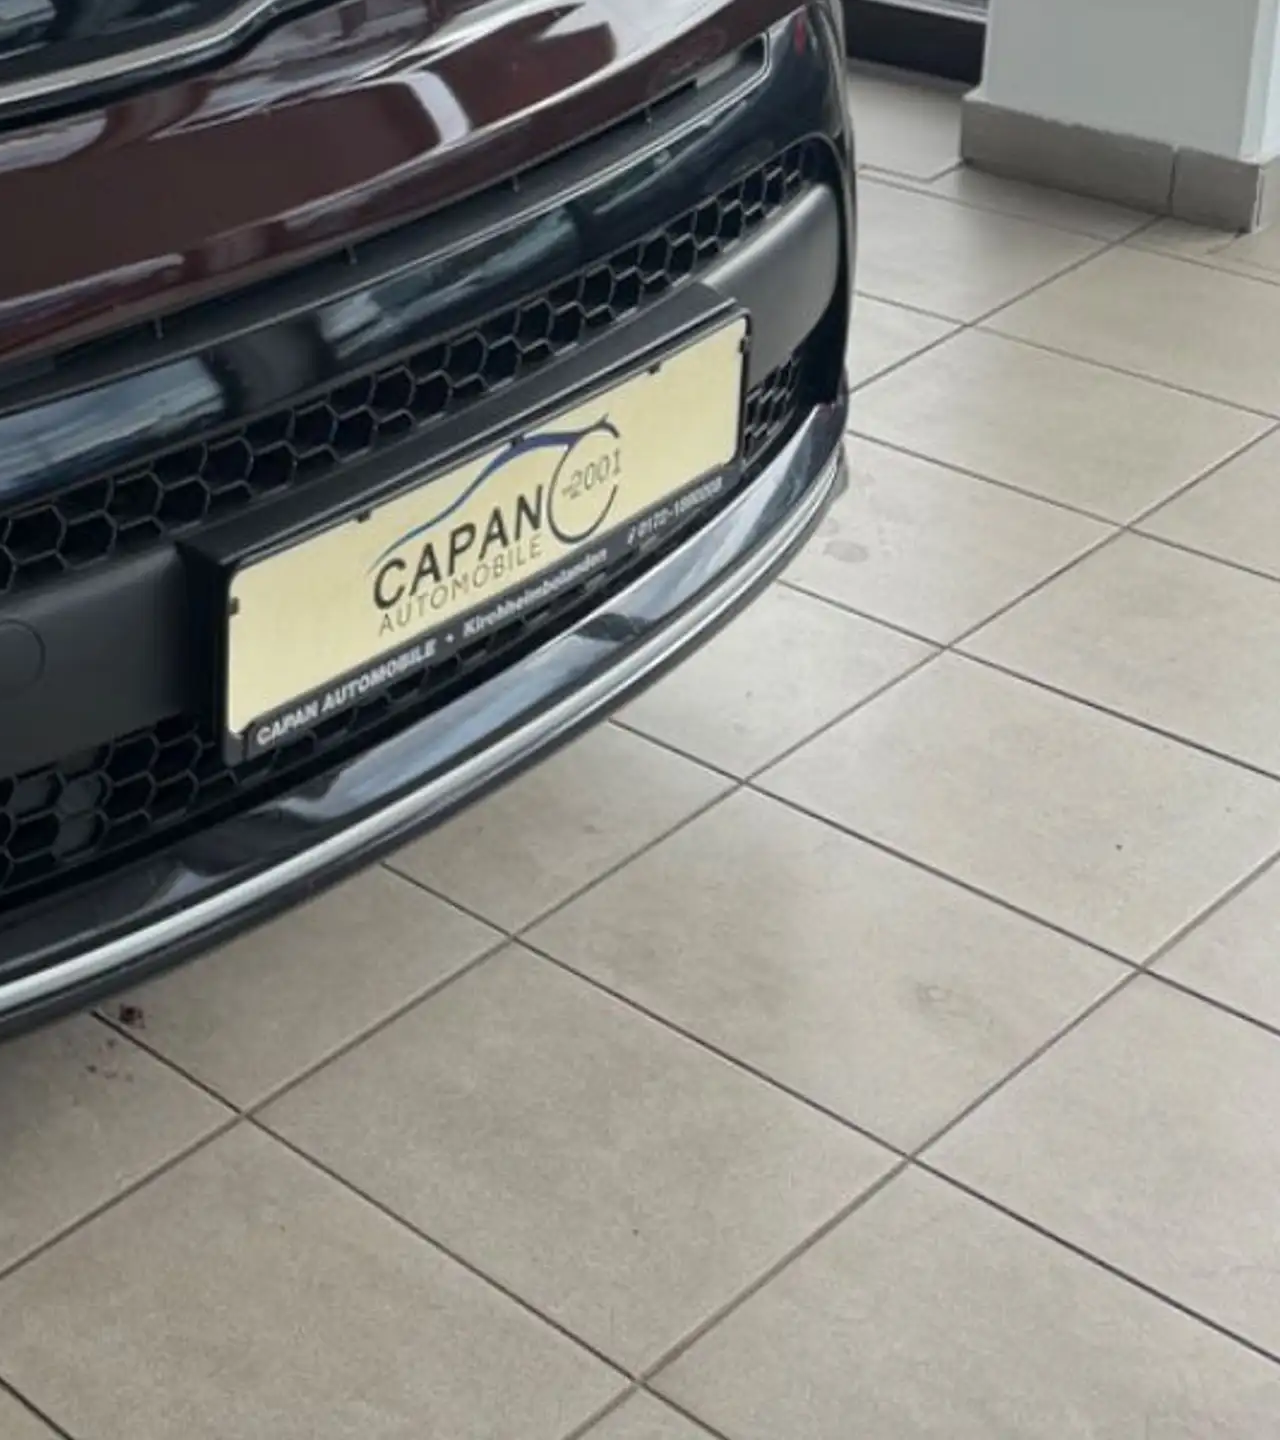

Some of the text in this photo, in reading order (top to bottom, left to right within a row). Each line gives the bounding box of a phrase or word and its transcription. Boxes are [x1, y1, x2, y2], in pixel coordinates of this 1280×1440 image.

[373, 483, 543, 610] CAPAN
[378, 534, 546, 637] AUTOMOBILE
[256, 700, 319, 745] CAPAN
[321, 637, 437, 712] AUTOMOBILE
